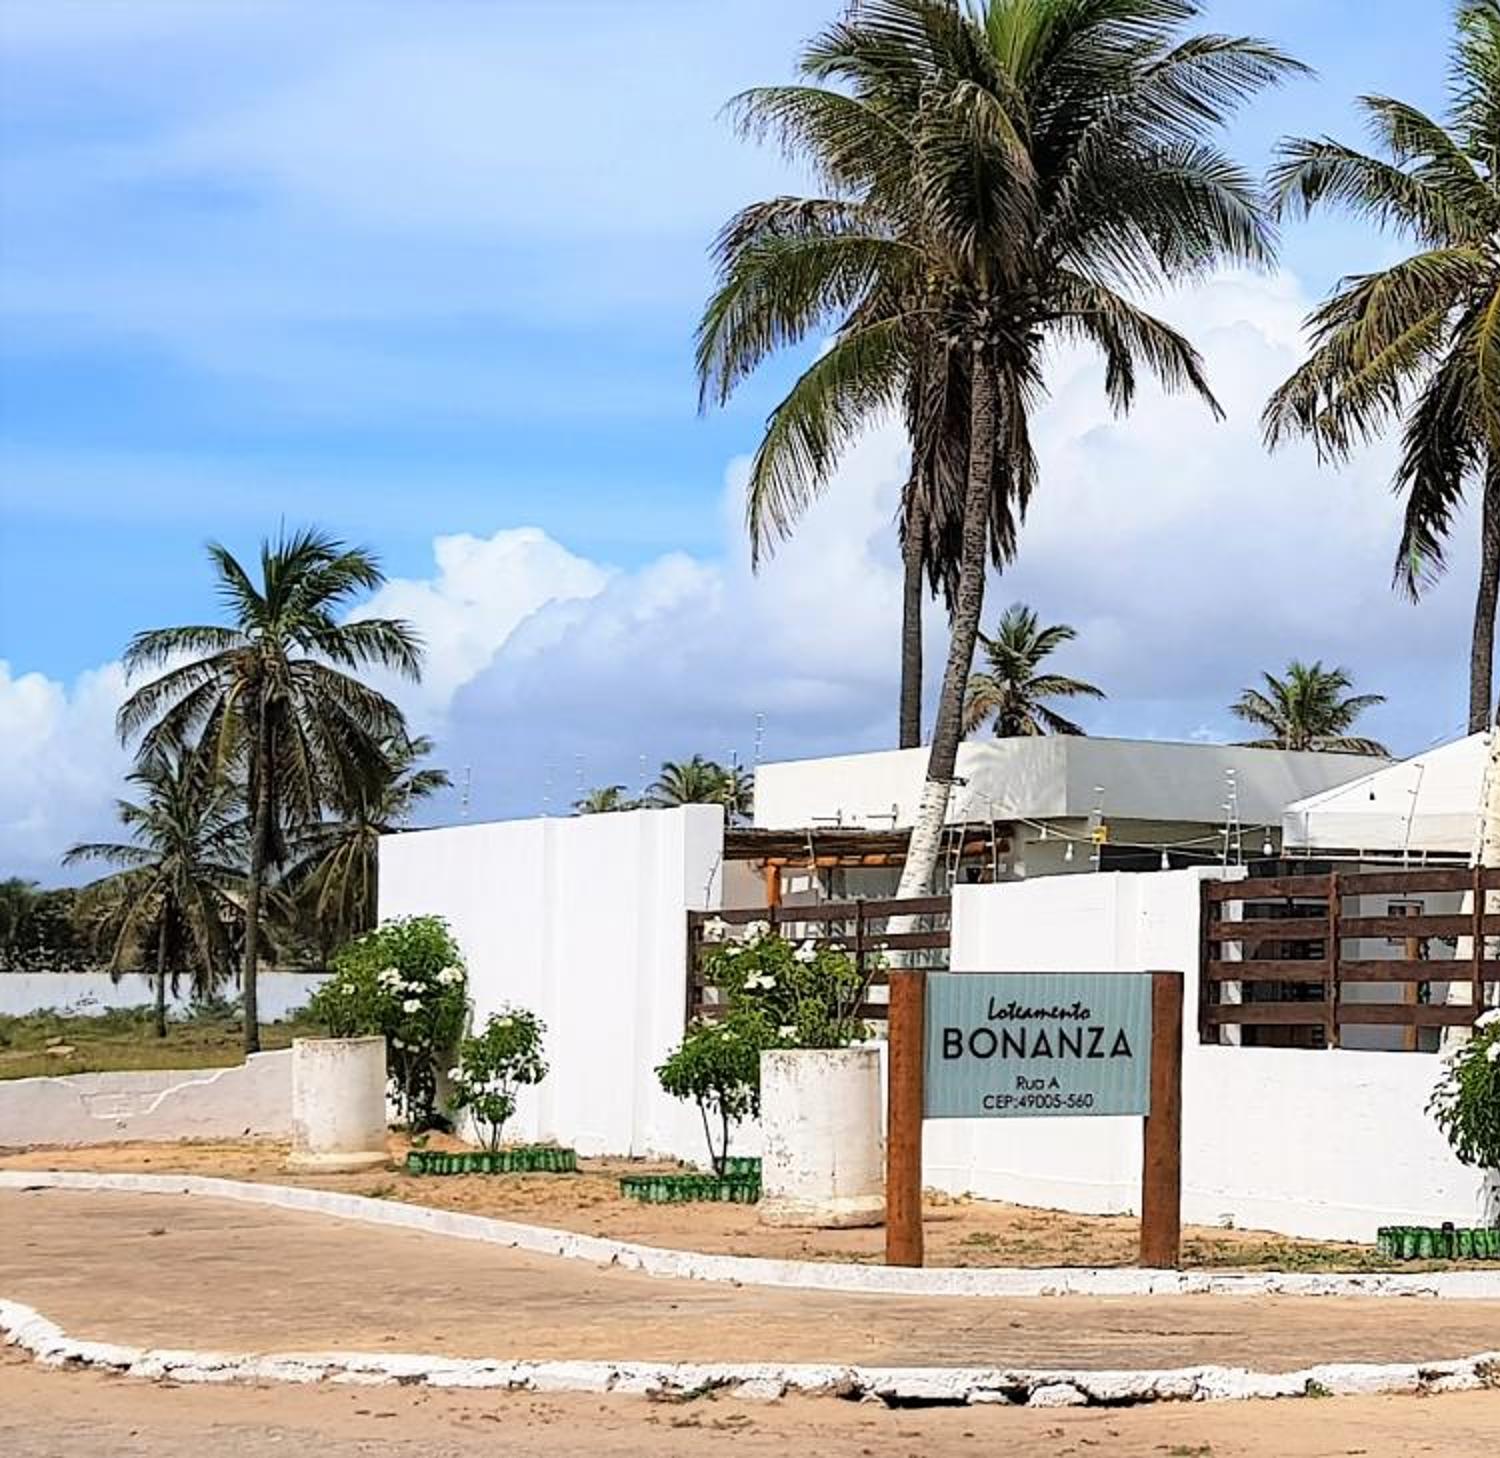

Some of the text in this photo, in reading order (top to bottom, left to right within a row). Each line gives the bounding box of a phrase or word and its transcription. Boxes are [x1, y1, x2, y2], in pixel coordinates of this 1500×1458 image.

[987, 997, 1091, 1021] Loteamento
[943, 1027, 1132, 1059] BONANZA
[1016, 1076, 1060, 1090] Rua A
[983, 1093, 1093, 1109] CEP:49005-560
